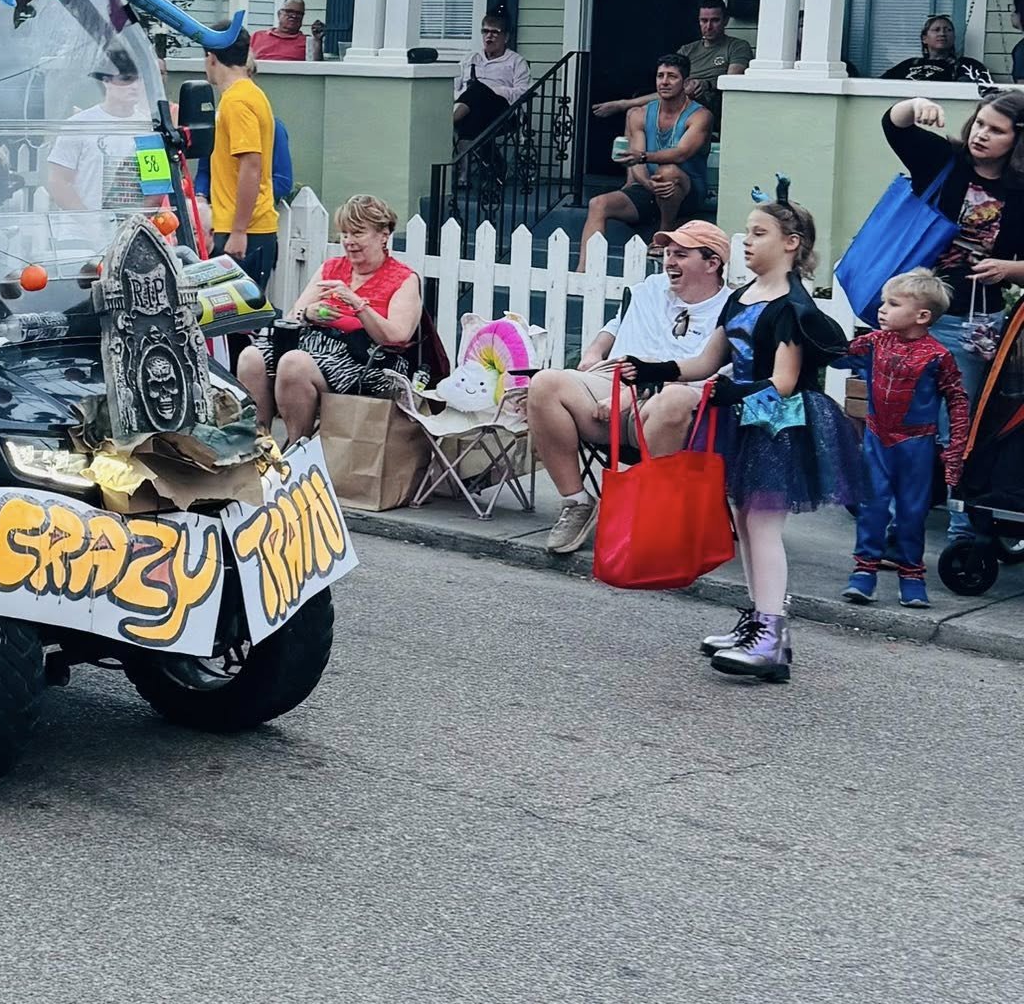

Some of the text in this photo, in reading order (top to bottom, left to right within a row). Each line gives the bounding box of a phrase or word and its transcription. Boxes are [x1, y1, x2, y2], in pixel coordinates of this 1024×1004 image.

[144, 155, 160, 173] 58
[128, 277, 165, 308] RIP
[233, 464, 347, 626] TRAIN
